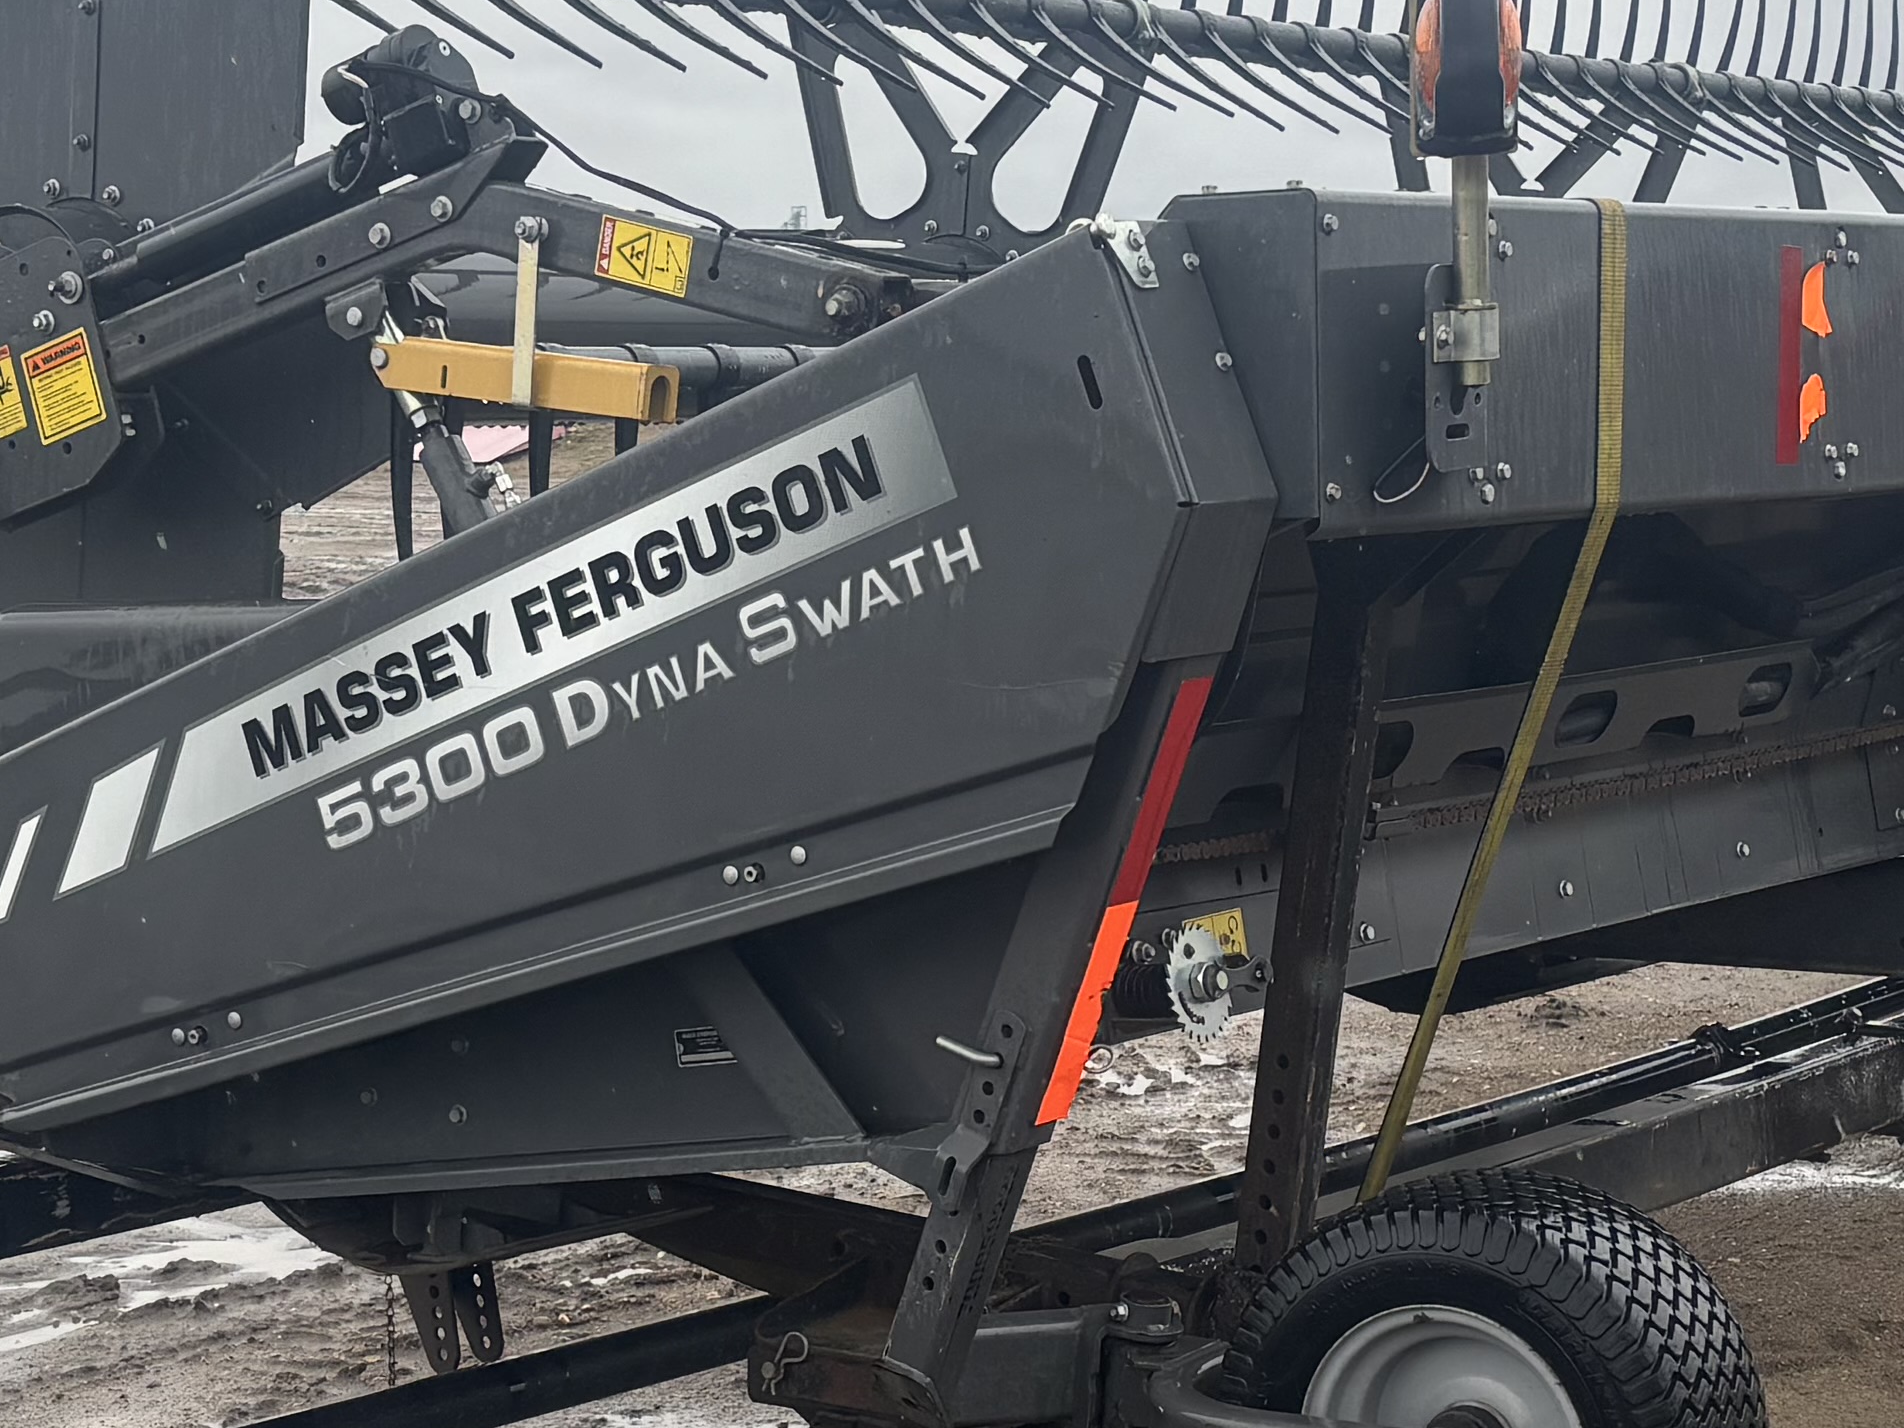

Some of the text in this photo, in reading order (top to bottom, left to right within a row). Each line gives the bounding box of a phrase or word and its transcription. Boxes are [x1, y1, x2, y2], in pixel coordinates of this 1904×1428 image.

[241, 434, 888, 779] MASSEY FERGUSON
[316, 706, 545, 850] 5300
